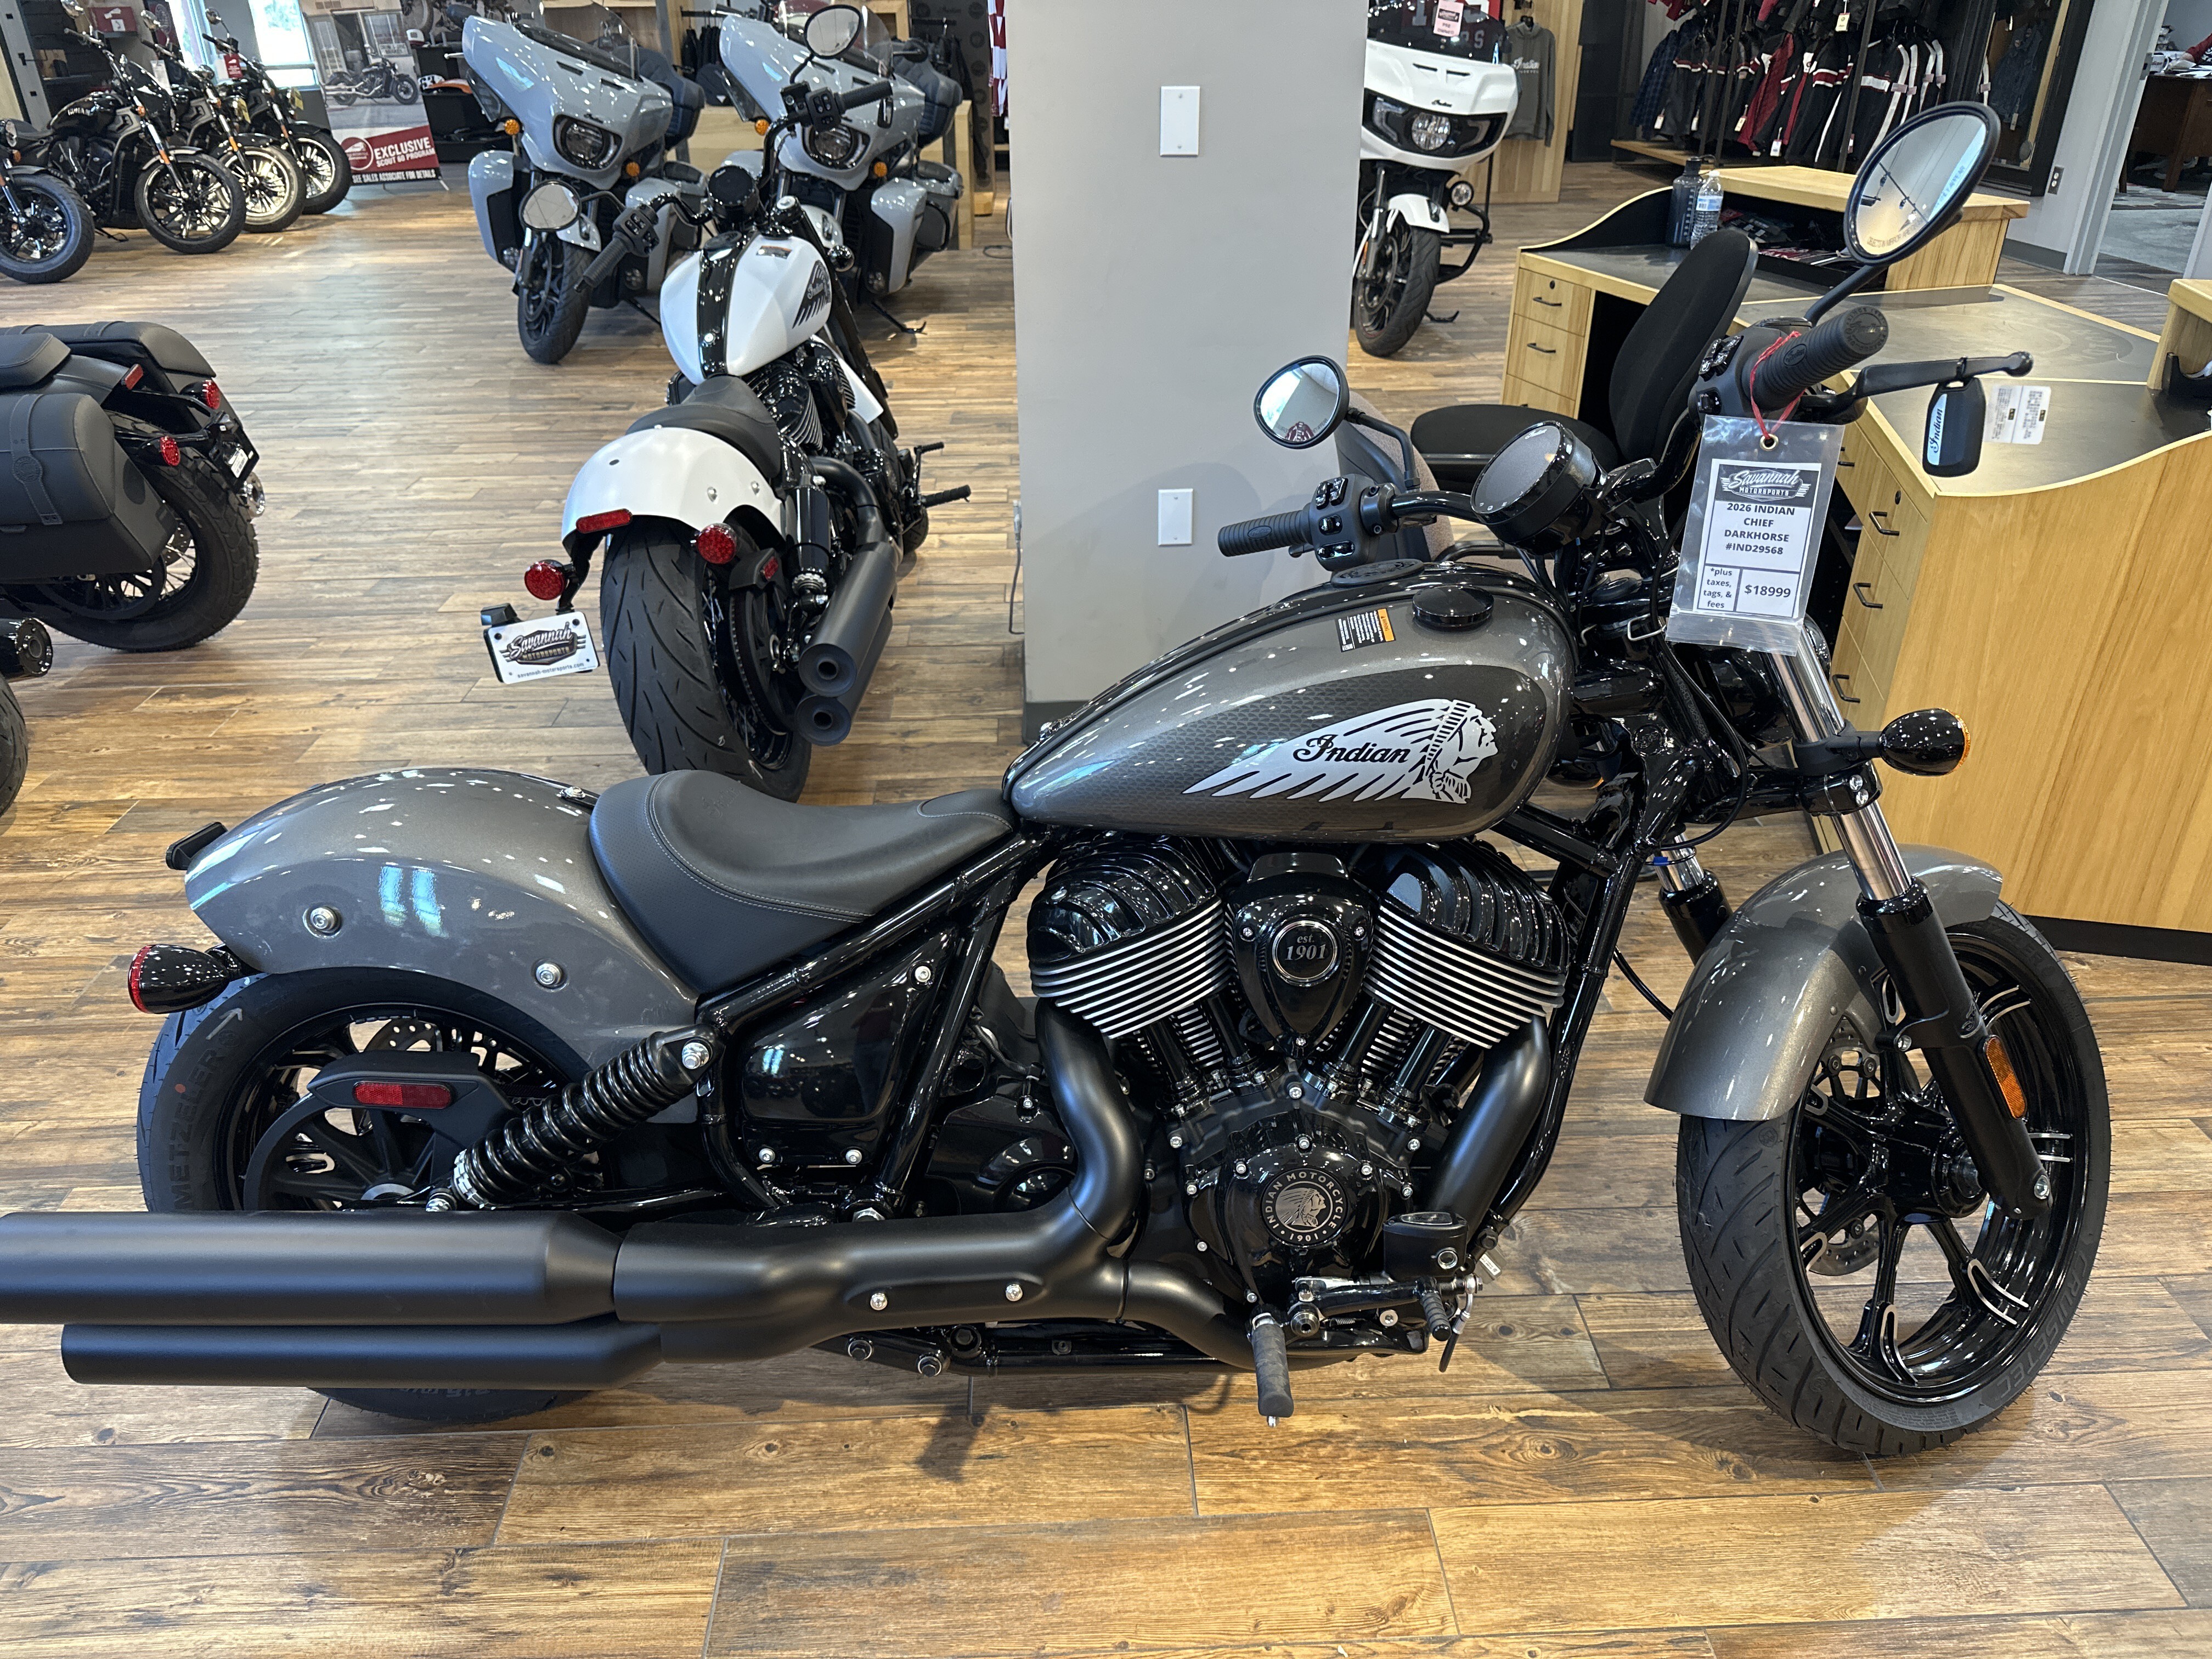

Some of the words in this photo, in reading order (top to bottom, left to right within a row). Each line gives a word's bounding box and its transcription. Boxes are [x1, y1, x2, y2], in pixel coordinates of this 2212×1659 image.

[374, 137, 431, 160] EXCLUSIVE
[376, 156, 396, 167] SCOUT
[407, 148, 436, 161] PROGRAM
[363, 172, 379, 183] SALES
[405, 170, 416, 180] FOR
[416, 169, 436, 179] DETAILS
[1929, 408, 1943, 454] Indian
[1728, 470, 1801, 489] Savannah
[1739, 486, 1789, 496] MOTORSPORTS
[1726, 503, 1752, 512] 2026
[1754, 505, 1795, 516] INDIAN
[1743, 517, 1774, 528] CHIEF
[1724, 529, 1790, 543] DARKHORSE
[1725, 542, 1784, 555] #IND29568
[1707, 579, 1731, 588] taxes,
[1703, 589, 1723, 599] tags,
[1744, 584, 1791, 598] $18999
[1707, 601, 1725, 609] fees
[509, 622, 572, 659] Savannah
[522, 646, 570, 661] MOTORSPORTS
[1293, 734, 1411, 763] Indian
[1297, 934, 1315, 943] est.
[1284, 944, 1326, 961] 1901
[1265, 1181, 1283, 1229] INDIAN
[1286, 1171, 1344, 1229] MOTORCYCLE
[1289, 1233, 1319, 1242] 1901
